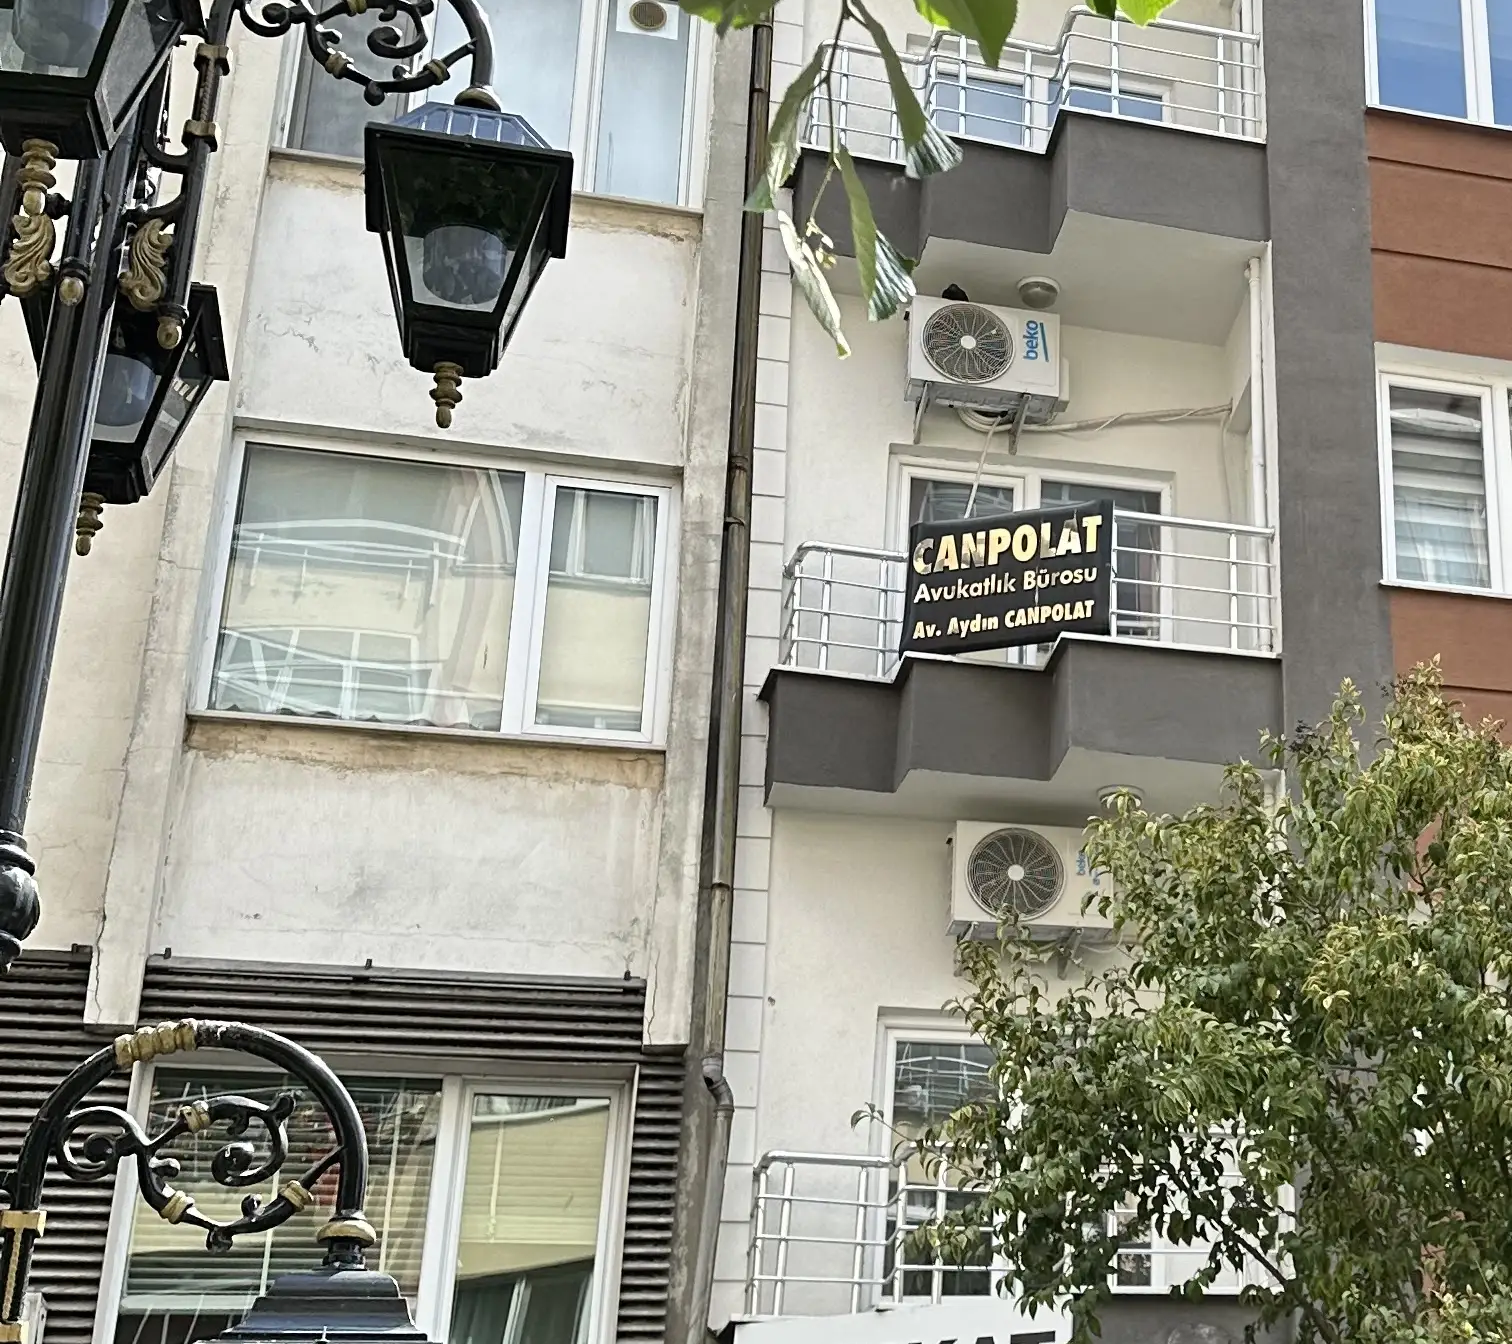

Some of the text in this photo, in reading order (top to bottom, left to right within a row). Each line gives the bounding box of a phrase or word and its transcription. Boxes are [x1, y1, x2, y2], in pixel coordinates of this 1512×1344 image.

[1023, 320, 1039, 360] beko
[912, 515, 1102, 575] CANPOLAT
[914, 567, 1098, 604] Avukatlık Bürosu
[913, 600, 1094, 639] Av. Aydın CANPOLAT
